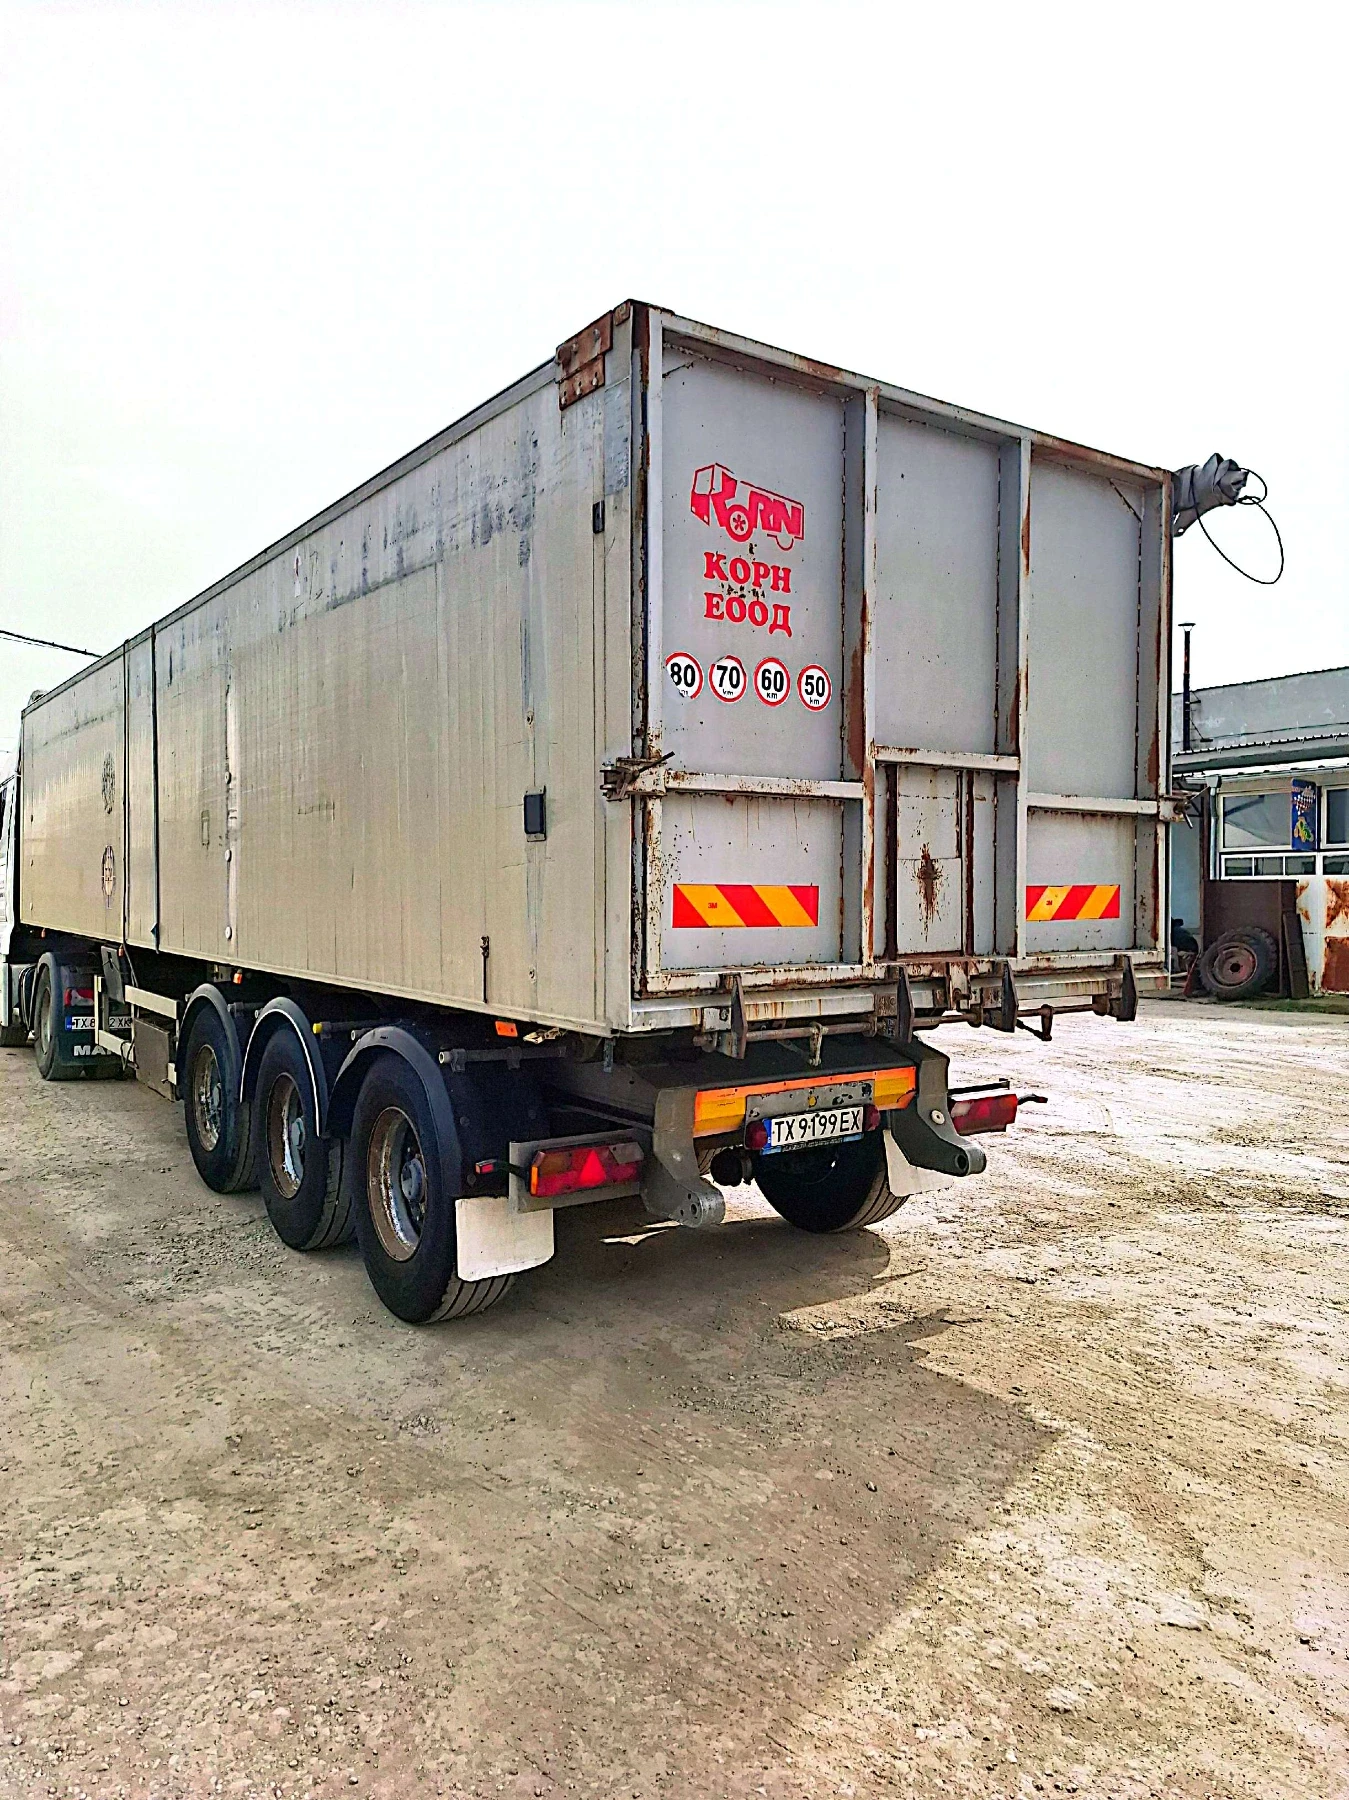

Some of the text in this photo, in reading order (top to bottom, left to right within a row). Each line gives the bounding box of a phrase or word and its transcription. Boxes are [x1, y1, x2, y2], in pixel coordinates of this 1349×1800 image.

[704, 552, 791, 593] КОРН
[704, 592, 792, 637] ЕООД
[670, 662, 696, 687] 80
[716, 665, 740, 688] 70
[761, 668, 784, 692] 60
[804, 675, 825, 697] 50
[809, 697, 820, 705] km
[73, 1045, 112, 1056] MA
